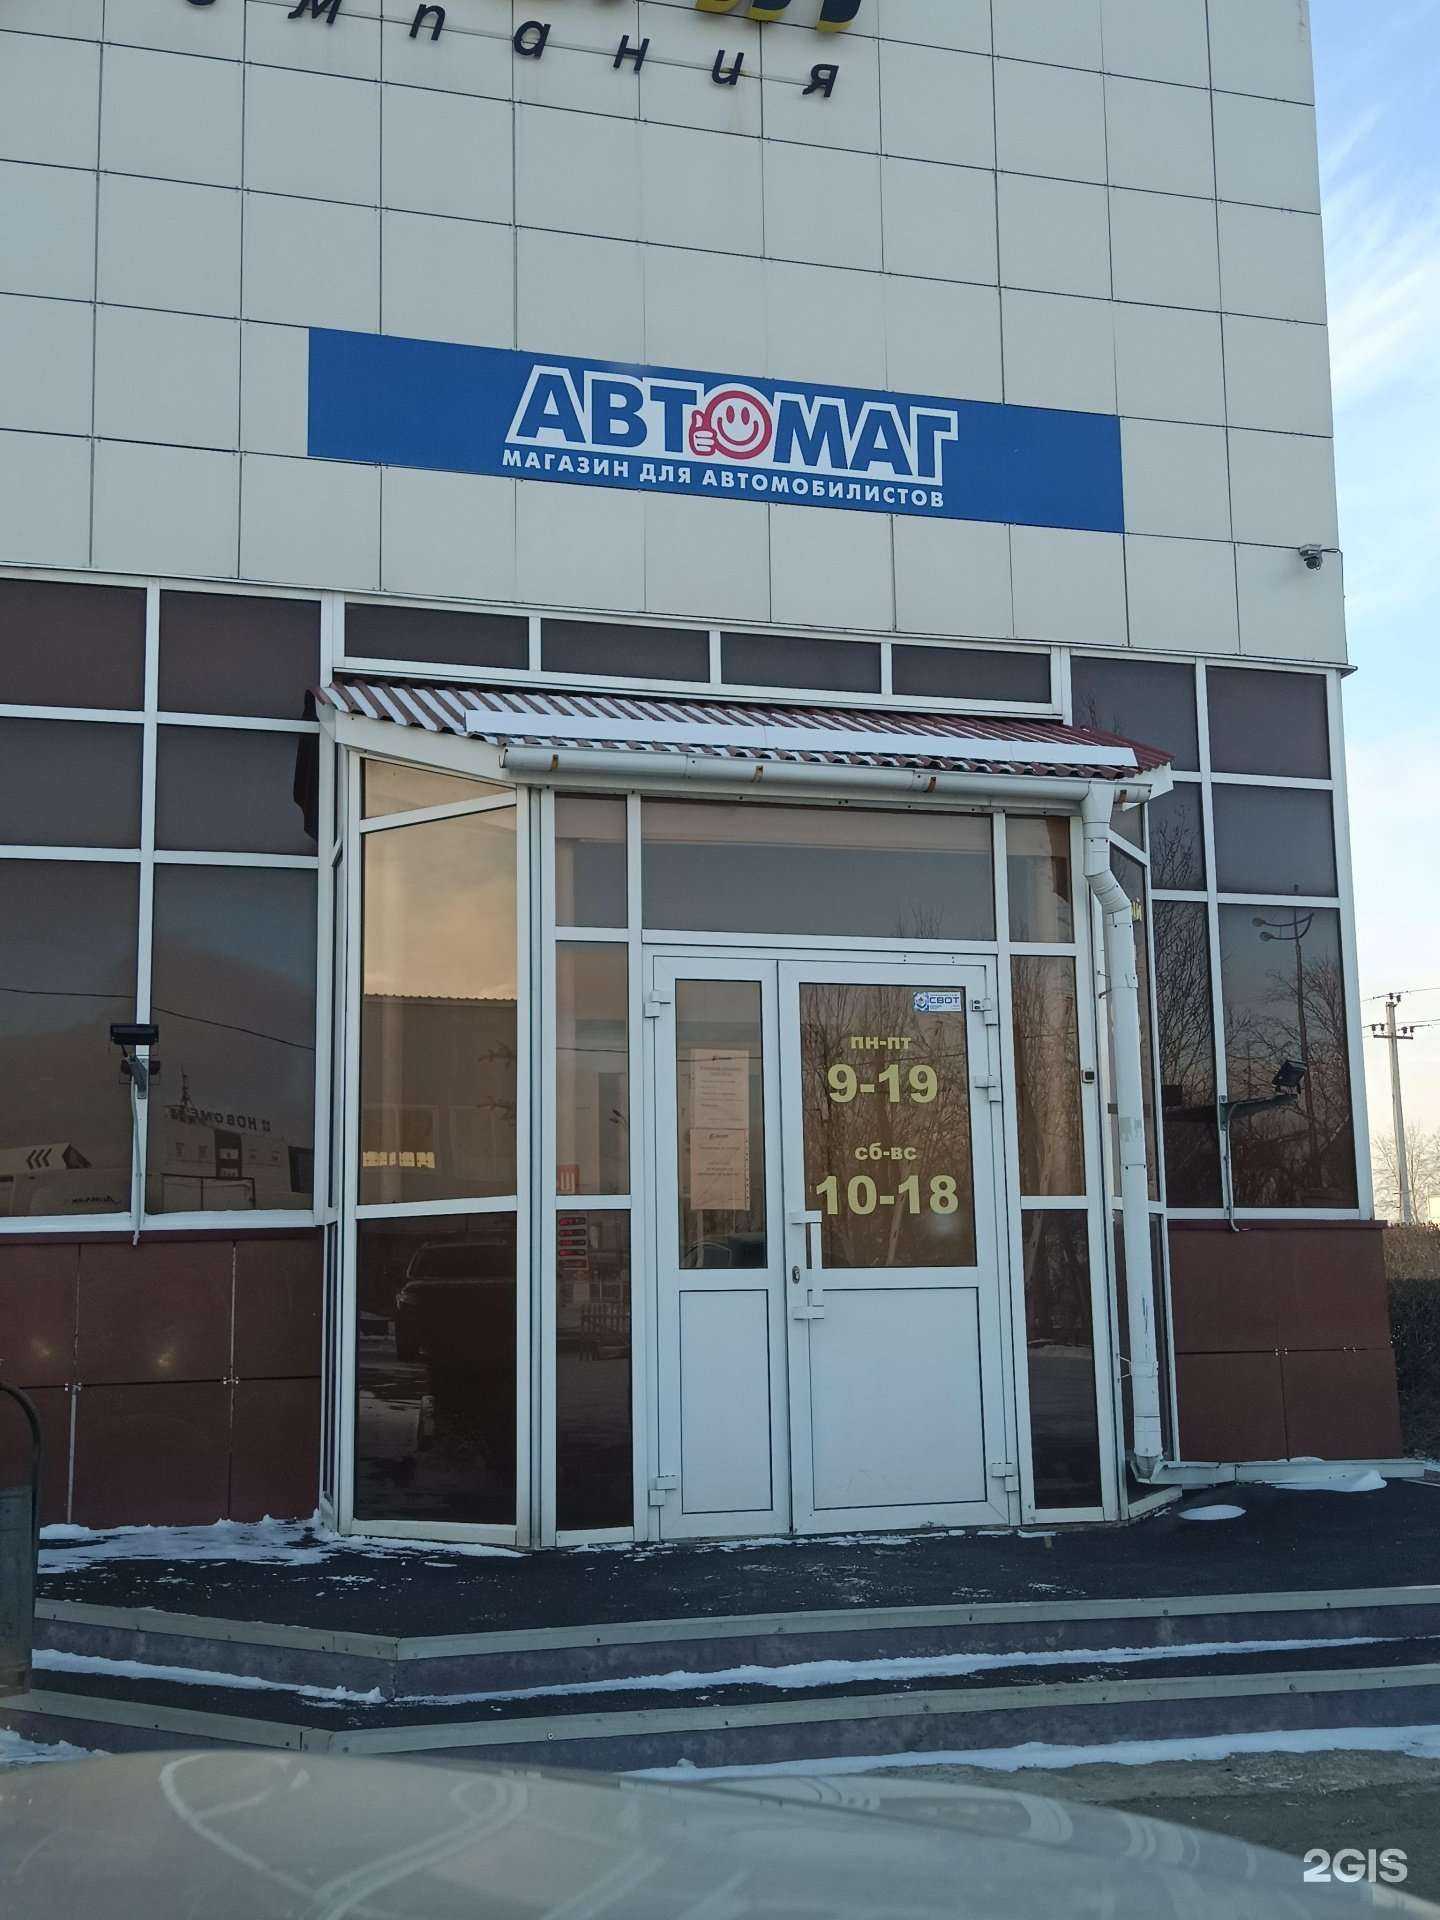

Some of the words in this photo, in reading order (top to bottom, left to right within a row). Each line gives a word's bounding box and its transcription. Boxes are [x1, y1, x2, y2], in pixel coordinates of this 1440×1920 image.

[186, 0, 839, 98] мпания
[505, 364, 959, 487] АВТОМАГ
[502, 448, 630, 478] МАГАЗИН
[639, 462, 692, 485] ДЛЯ
[702, 469, 945, 508] АВТОМОБИЛИСТОВ
[827, 1063, 938, 1104] 9-19
[854, 1142, 918, 1161] сб-вс
[815, 1174, 960, 1215] 10-18
